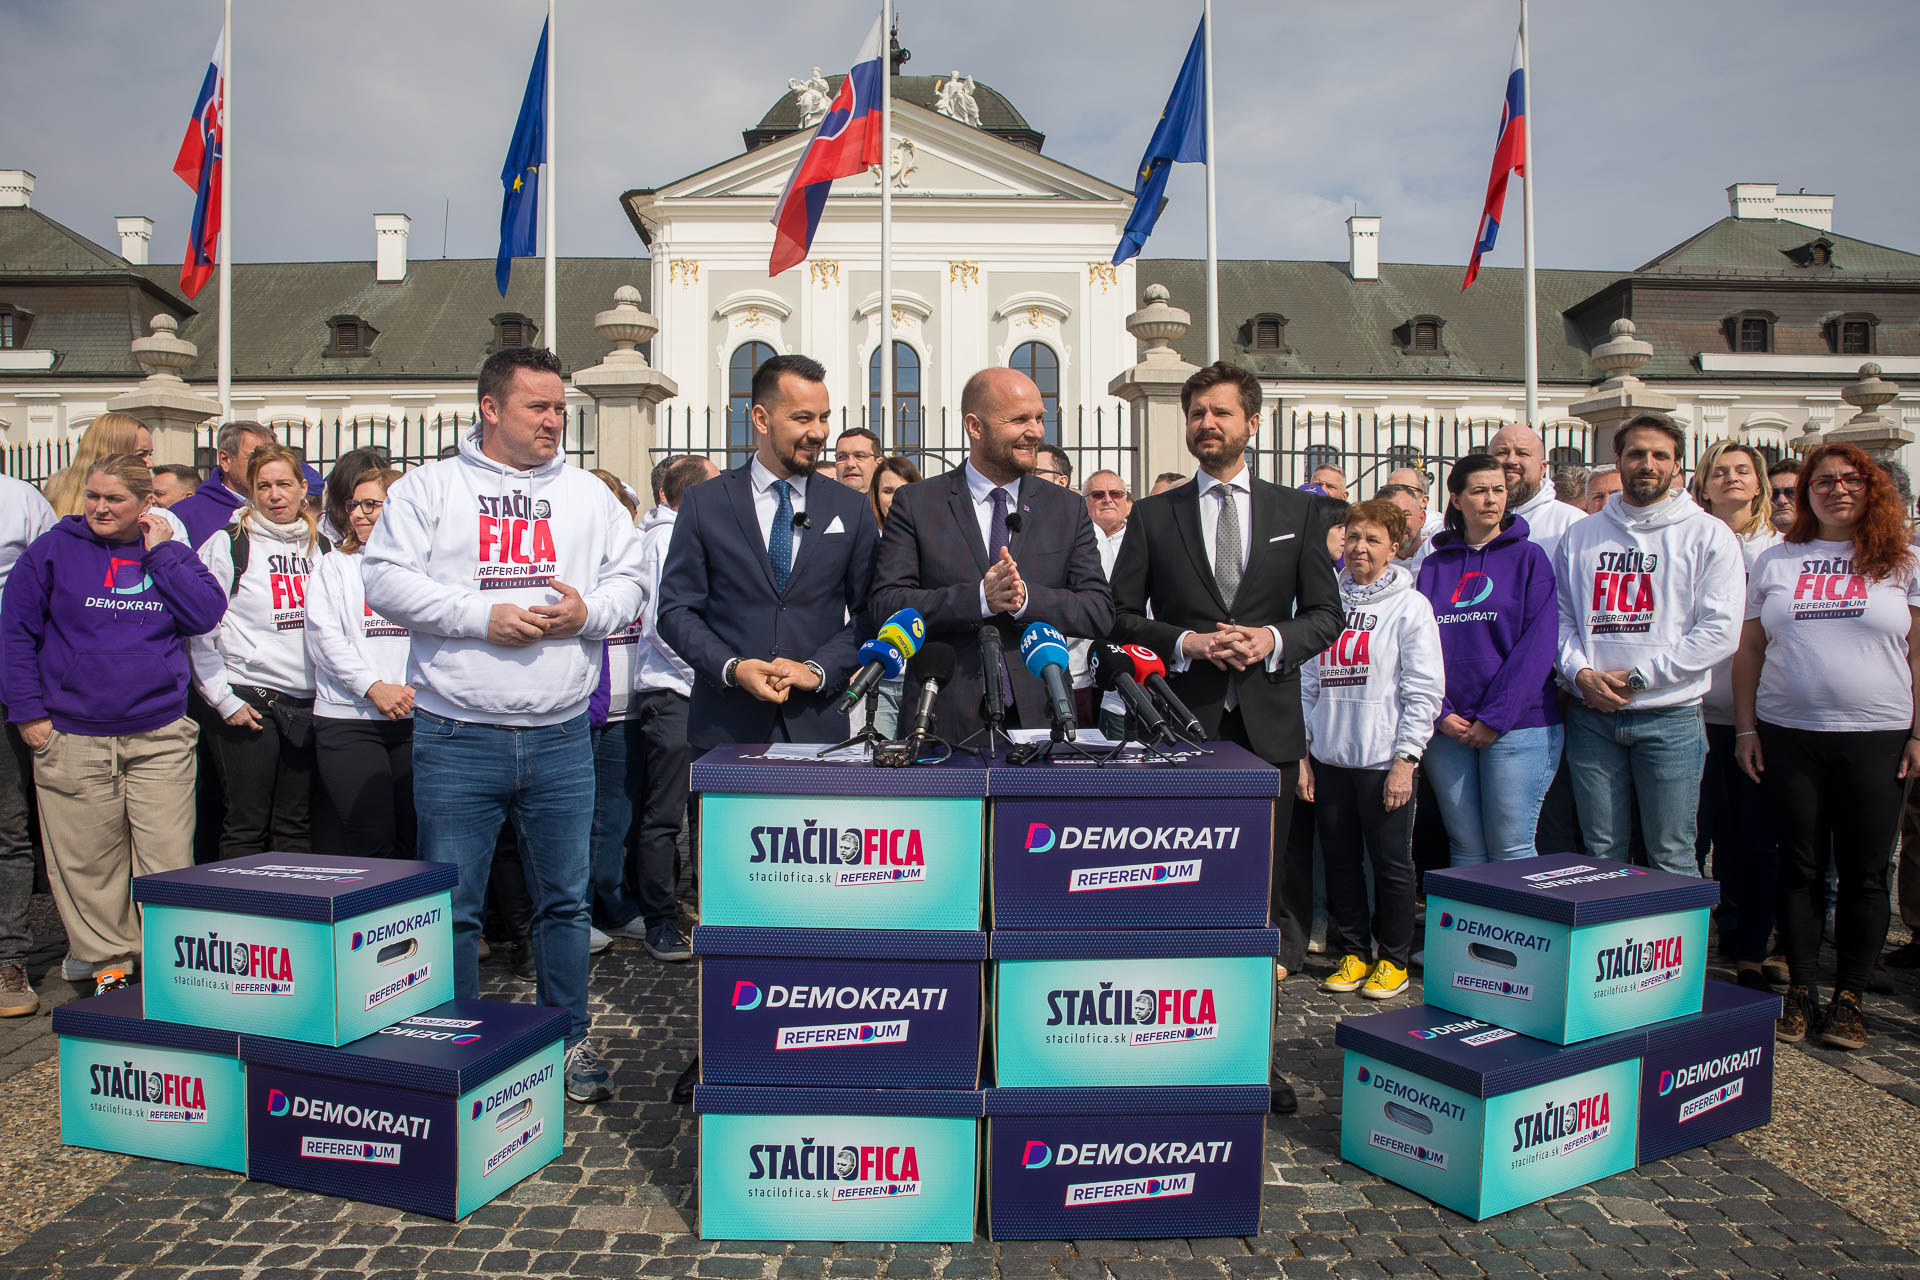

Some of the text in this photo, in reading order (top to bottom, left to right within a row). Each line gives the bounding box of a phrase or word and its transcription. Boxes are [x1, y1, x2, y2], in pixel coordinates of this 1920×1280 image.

[479, 515, 556, 564] FICA
[478, 564, 556, 577] REFERENDUM
[1596, 548, 1657, 573] STAČILO
[1800, 557, 1857, 574] STAČIL
[1592, 572, 1655, 613] FICA
[1793, 574, 1868, 600] FICA
[85, 597, 164, 612] DEMOKRATI
[1793, 600, 1867, 610] REFERENDUM
[1437, 612, 1498, 625] DEMOKRATI
[1591, 612, 1653, 624] REFERENDUM
[1020, 629, 1039, 654] HN
[1042, 627, 1067, 644] HN
[1320, 666, 1369, 677] REFERENDUM
[1059, 827, 1240, 850] DEMOKRATI
[749, 872, 832, 884] stacilofica.sk
[840, 868, 921, 884] REFERENDUM
[1077, 863, 1194, 887] REFERENDUM
[366, 908, 441, 946] DEMOKRATI
[1456, 918, 1551, 953] DEMOKRATI
[174, 976, 230, 990] stacilofica.sk
[235, 983, 291, 993] REFERENDUM
[368, 966, 428, 1005] REFERENDUM
[1457, 976, 1529, 995] REFERENDUM
[1640, 968, 1680, 988] REFERENDUM
[765, 985, 948, 1011] DEMOKRATI
[1593, 981, 1637, 999] stacilofica.sk
[784, 1024, 901, 1045] REFERENDUM
[1045, 1032, 1126, 1044] stacilofica.sk
[1135, 1026, 1213, 1043] REFERENDUM
[1675, 1046, 1762, 1089] DEMOKRATI
[485, 1064, 554, 1113] DEMOKRATI
[1373, 1074, 1465, 1122] DEMOKRATI
[90, 1102, 145, 1118] stacilofica.sk
[1682, 1082, 1740, 1118] REFERENDUM
[150, 1111, 204, 1122] REFERENDUM
[292, 1096, 431, 1140] DEMOKRATI
[487, 1121, 541, 1170] REFERENDUM
[1373, 1133, 1444, 1164] REFERENDUM
[1563, 1126, 1608, 1153] REFERENDUM
[306, 1141, 395, 1160] REFERENDUM
[1055, 1141, 1233, 1166] DEMOKRATI
[1511, 1145, 1559, 1169] stacilofica.sk
[748, 1187, 829, 1198] stacilofica.sk
[837, 1184, 916, 1198] REFERENDUM
[1073, 1177, 1187, 1201] REFERENDUM
